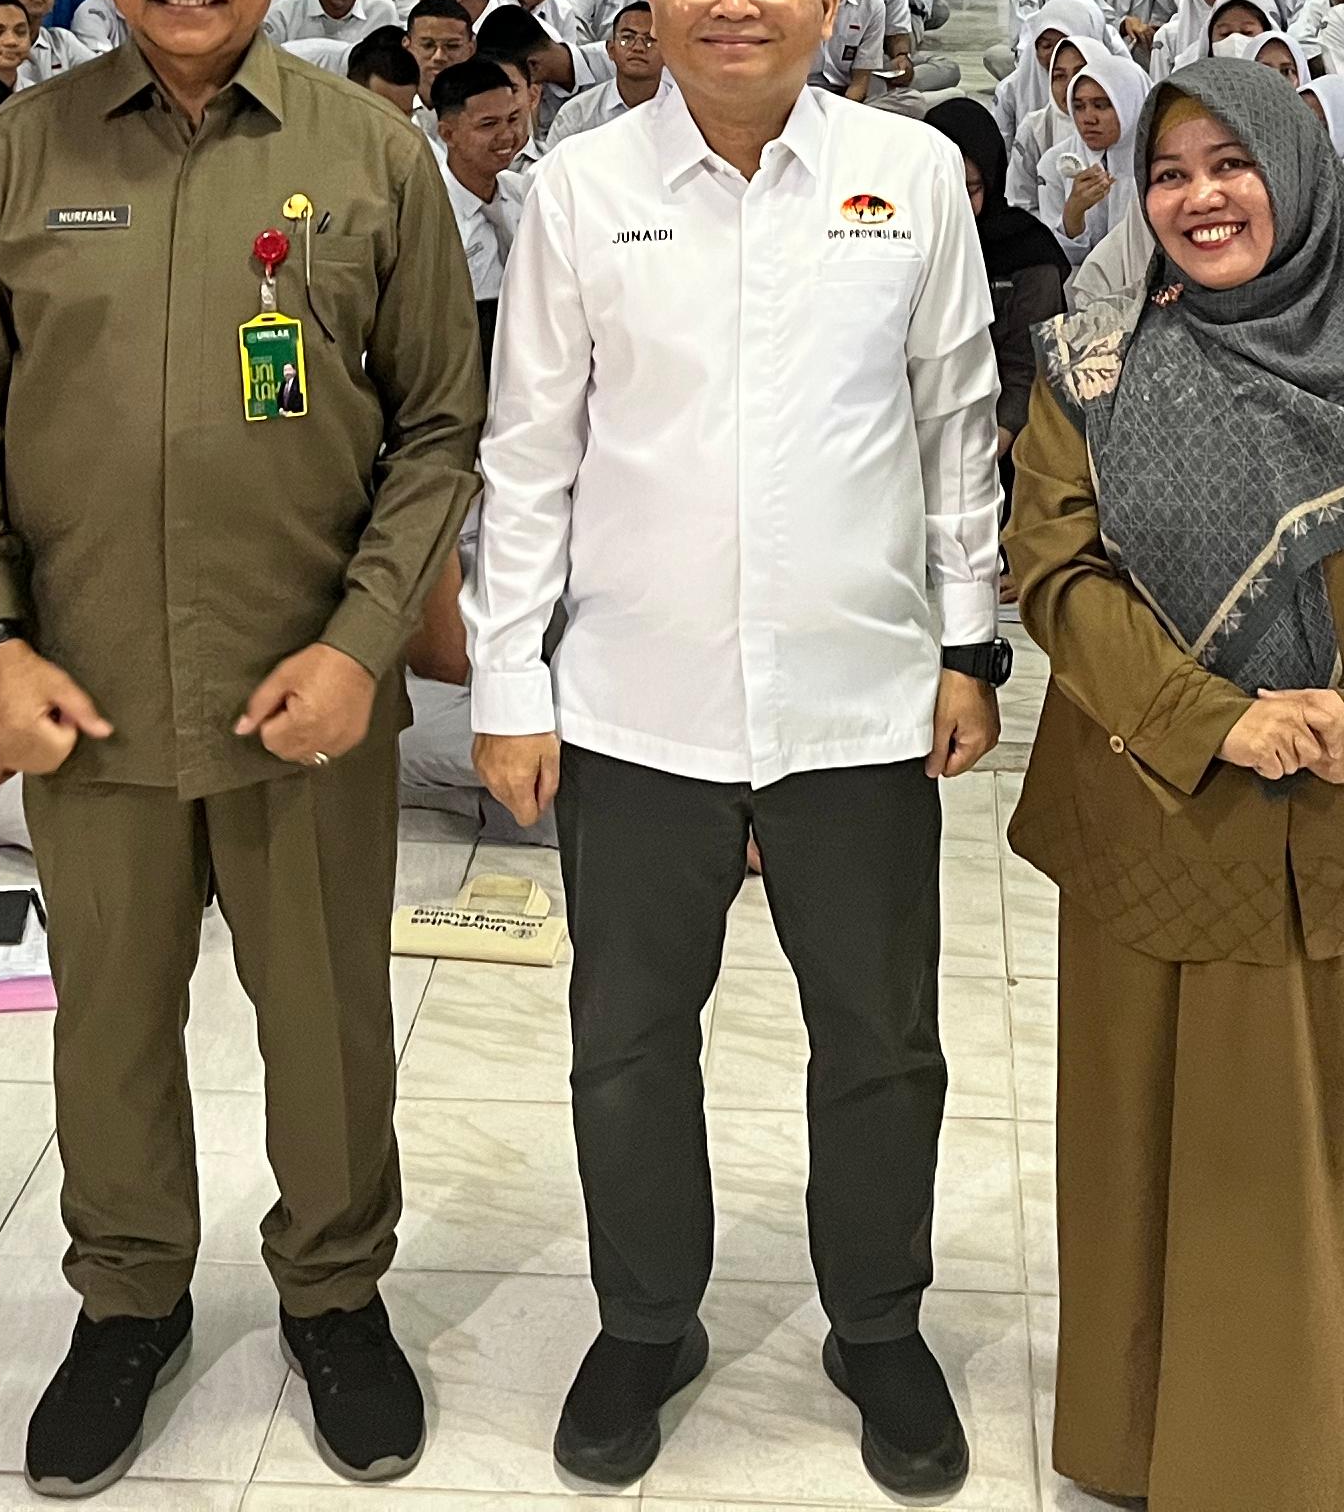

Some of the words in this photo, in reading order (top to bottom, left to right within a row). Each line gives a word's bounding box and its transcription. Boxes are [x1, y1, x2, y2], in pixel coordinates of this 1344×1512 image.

[58, 210, 117, 223] NURFAISAL
[612, 228, 673, 244] JUNAIDI
[849, 228, 891, 240] PROVINSI
[892, 229, 912, 240] RIAU
[410, 916, 507, 933] Universitas
